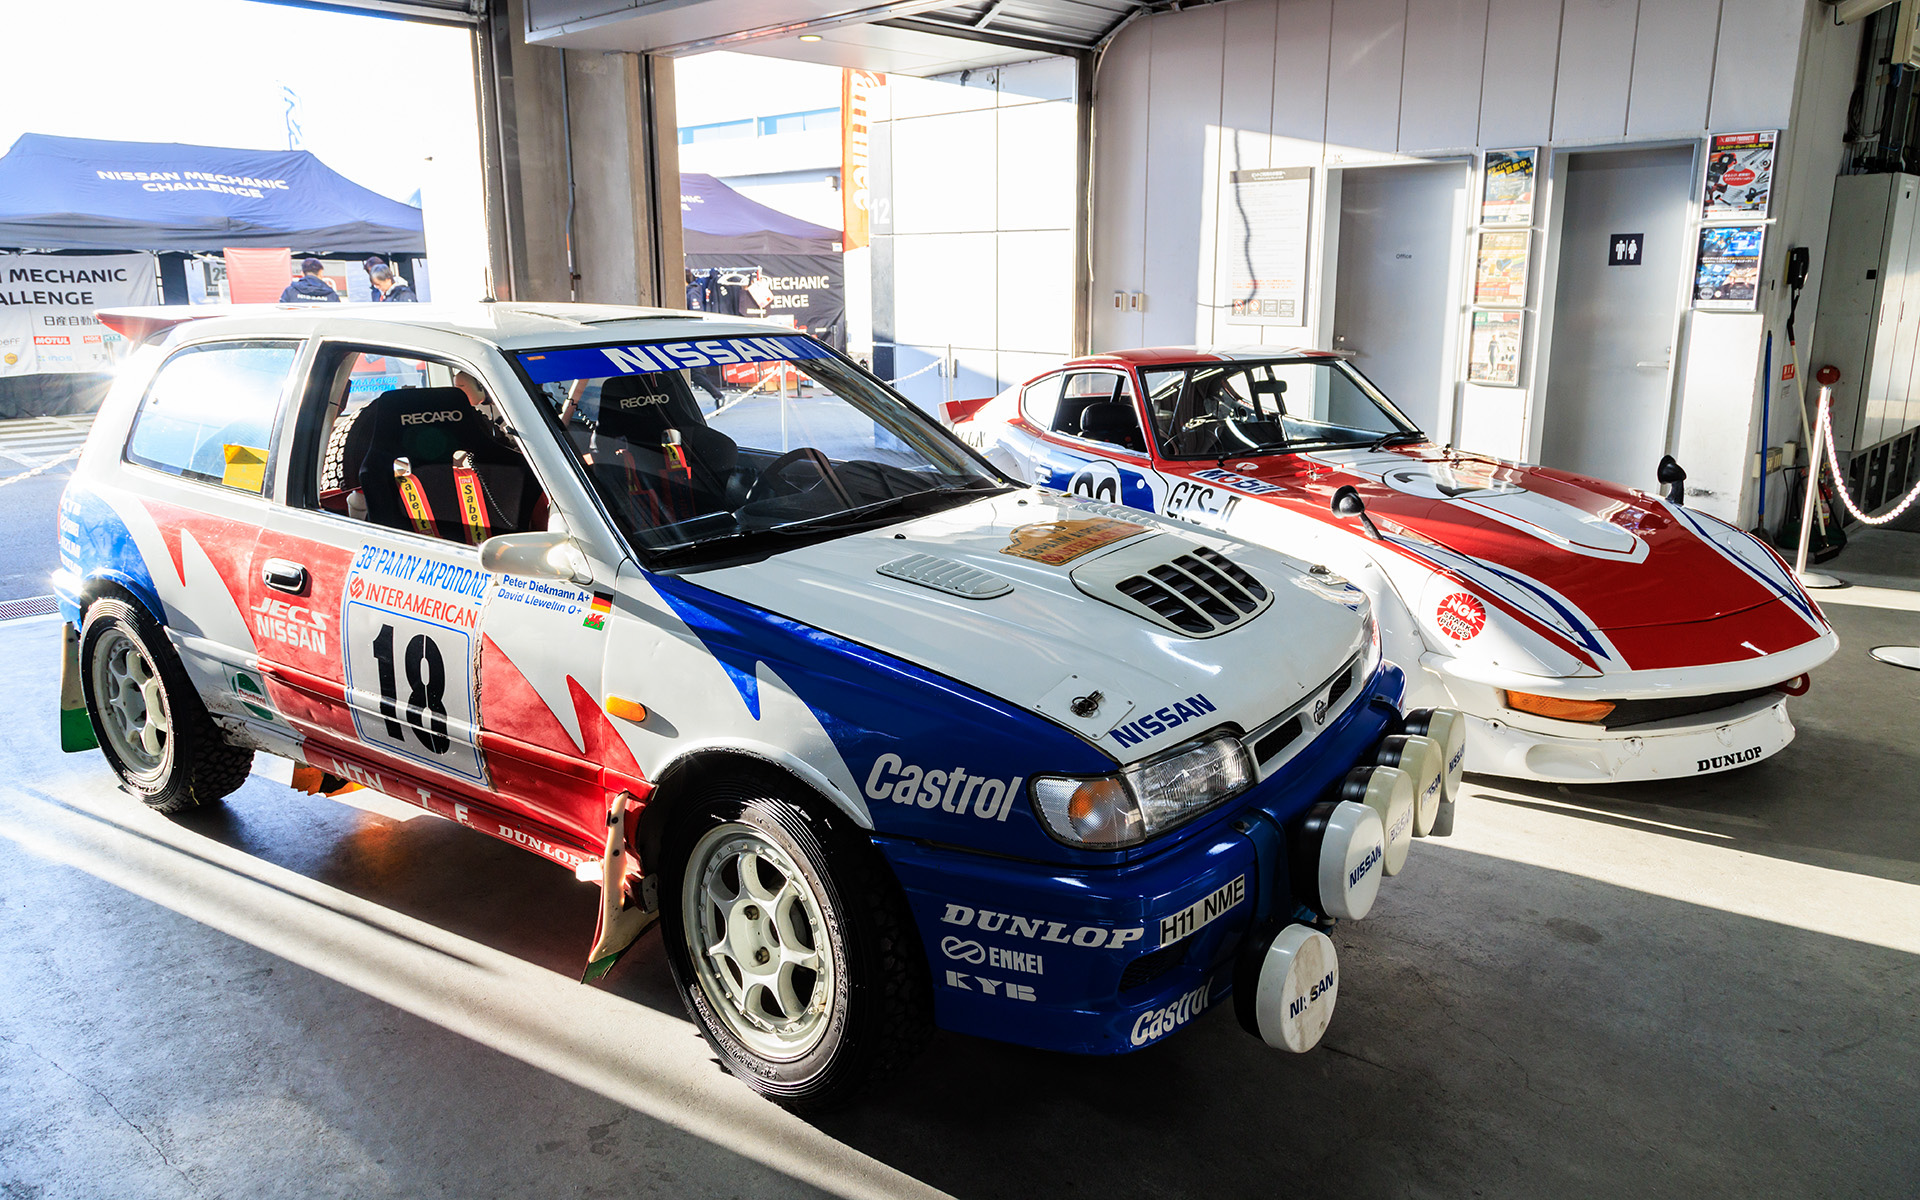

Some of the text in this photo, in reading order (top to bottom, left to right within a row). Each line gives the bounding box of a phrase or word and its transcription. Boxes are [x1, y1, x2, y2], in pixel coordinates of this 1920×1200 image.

[96, 170, 290, 190] NISSAN MECHANIC
[142, 182, 265, 198] CHALLENGE
[870, 198, 890, 225] 12
[9, 268, 128, 284] MECHANIC
[35, 337, 70, 345] MOTUL
[604, 335, 799, 374] NISSAN
[620, 393, 670, 410] RECARO
[401, 410, 463, 426] RECARO
[1197, 467, 1282, 494] Mobil
[464, 484, 483, 541] Sabelt
[497, 588, 582, 615] David Llewellin O+
[503, 574, 590, 603] Peter Diekmann A+
[250, 596, 331, 632] JECS
[365, 582, 478, 629] INTERAMERICAN
[1447, 597, 1481, 624] NGK
[256, 613, 327, 656] NISSAN
[1440, 618, 1469, 638] PLUGS
[1443, 611, 1471, 632] SPARK
[372, 623, 451, 756] 18
[1109, 693, 1217, 749] NISSAN
[1697, 746, 1763, 773] DUNLOP
[331, 757, 387, 794] NTN
[865, 752, 1023, 822] Castrol
[1349, 843, 1382, 889] NISSAN
[1160, 874, 1245, 946] H11 NME
[940, 903, 1144, 950] DUNLOP
[989, 947, 1044, 975] ENKEI
[946, 970, 1036, 1002] KYB
[1130, 976, 1213, 1048] Castrol
